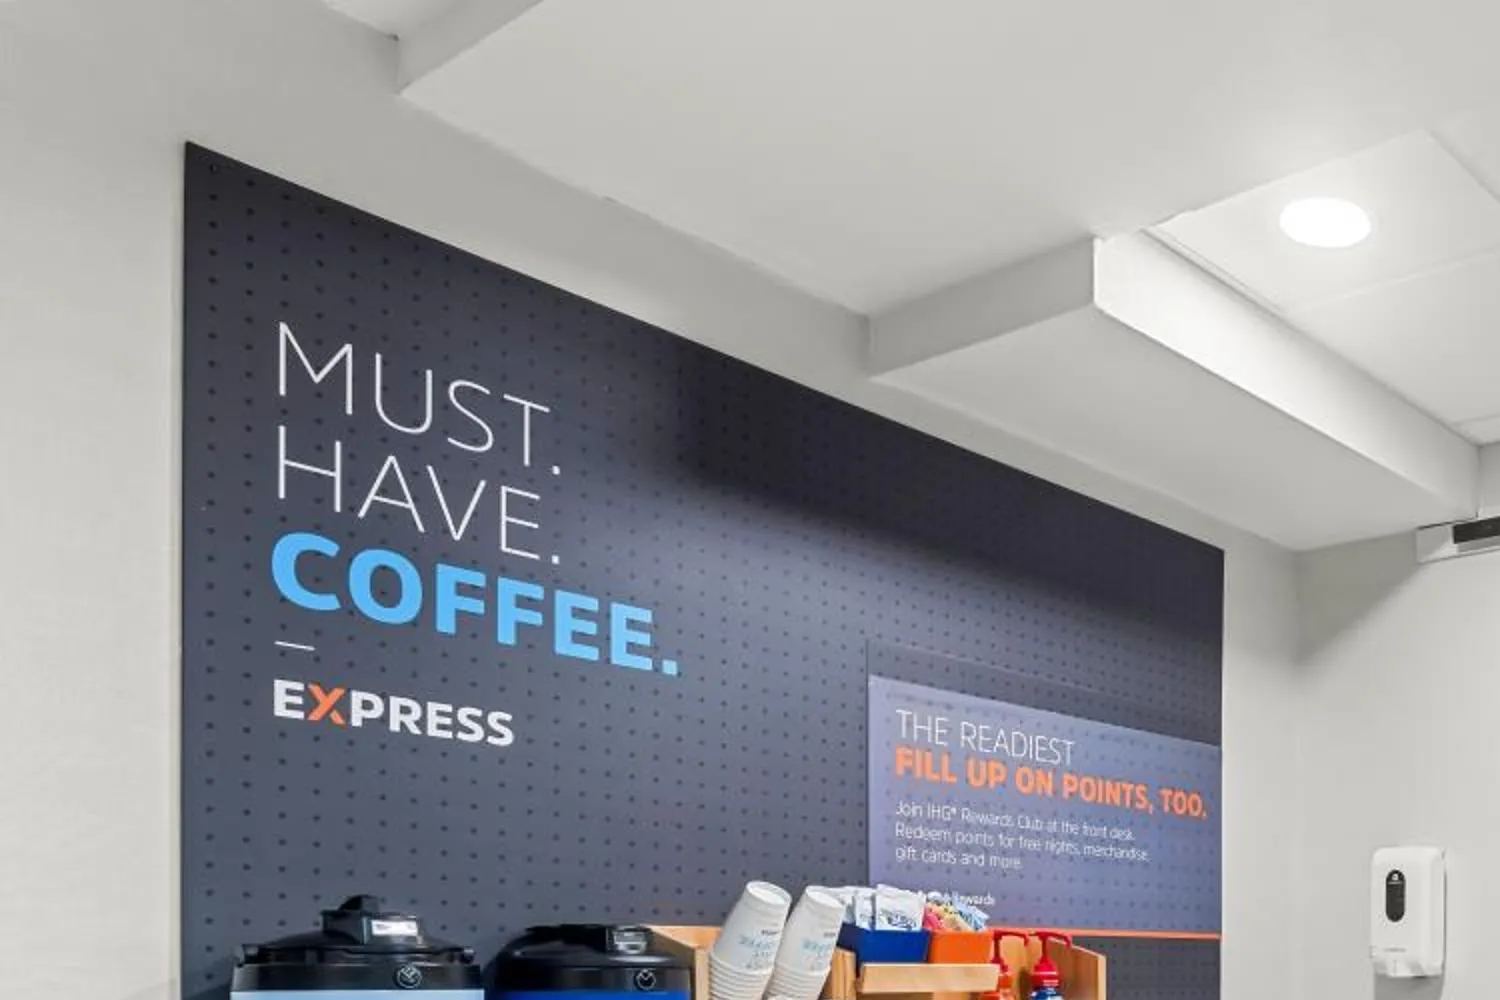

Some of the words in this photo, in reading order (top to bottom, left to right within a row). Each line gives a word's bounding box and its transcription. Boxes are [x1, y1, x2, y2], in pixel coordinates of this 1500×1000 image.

[279, 321, 561, 476] MUST.
[278, 424, 560, 564] HAVE.
[271, 531, 679, 677] COFFEE.
[273, 678, 514, 746] EXPRESS
[895, 709, 949, 747] THE
[960, 720, 1075, 766] READIEST
[895, 746, 958, 784] FILL
[967, 756, 1007, 789] UP
[1015, 765, 1053, 797] ON
[1062, 772, 1153, 814] POINTS,
[1160, 786, 1208, 820] TOO.
[896, 800, 923, 818] Join
[961, 807, 1014, 827] Rewards
[1017, 815, 1042, 831] Club
[896, 821, 952, 842] Redeem
[955, 830, 995, 849] points
[921, 847, 957, 866] cards
[961, 851, 985, 867] and
